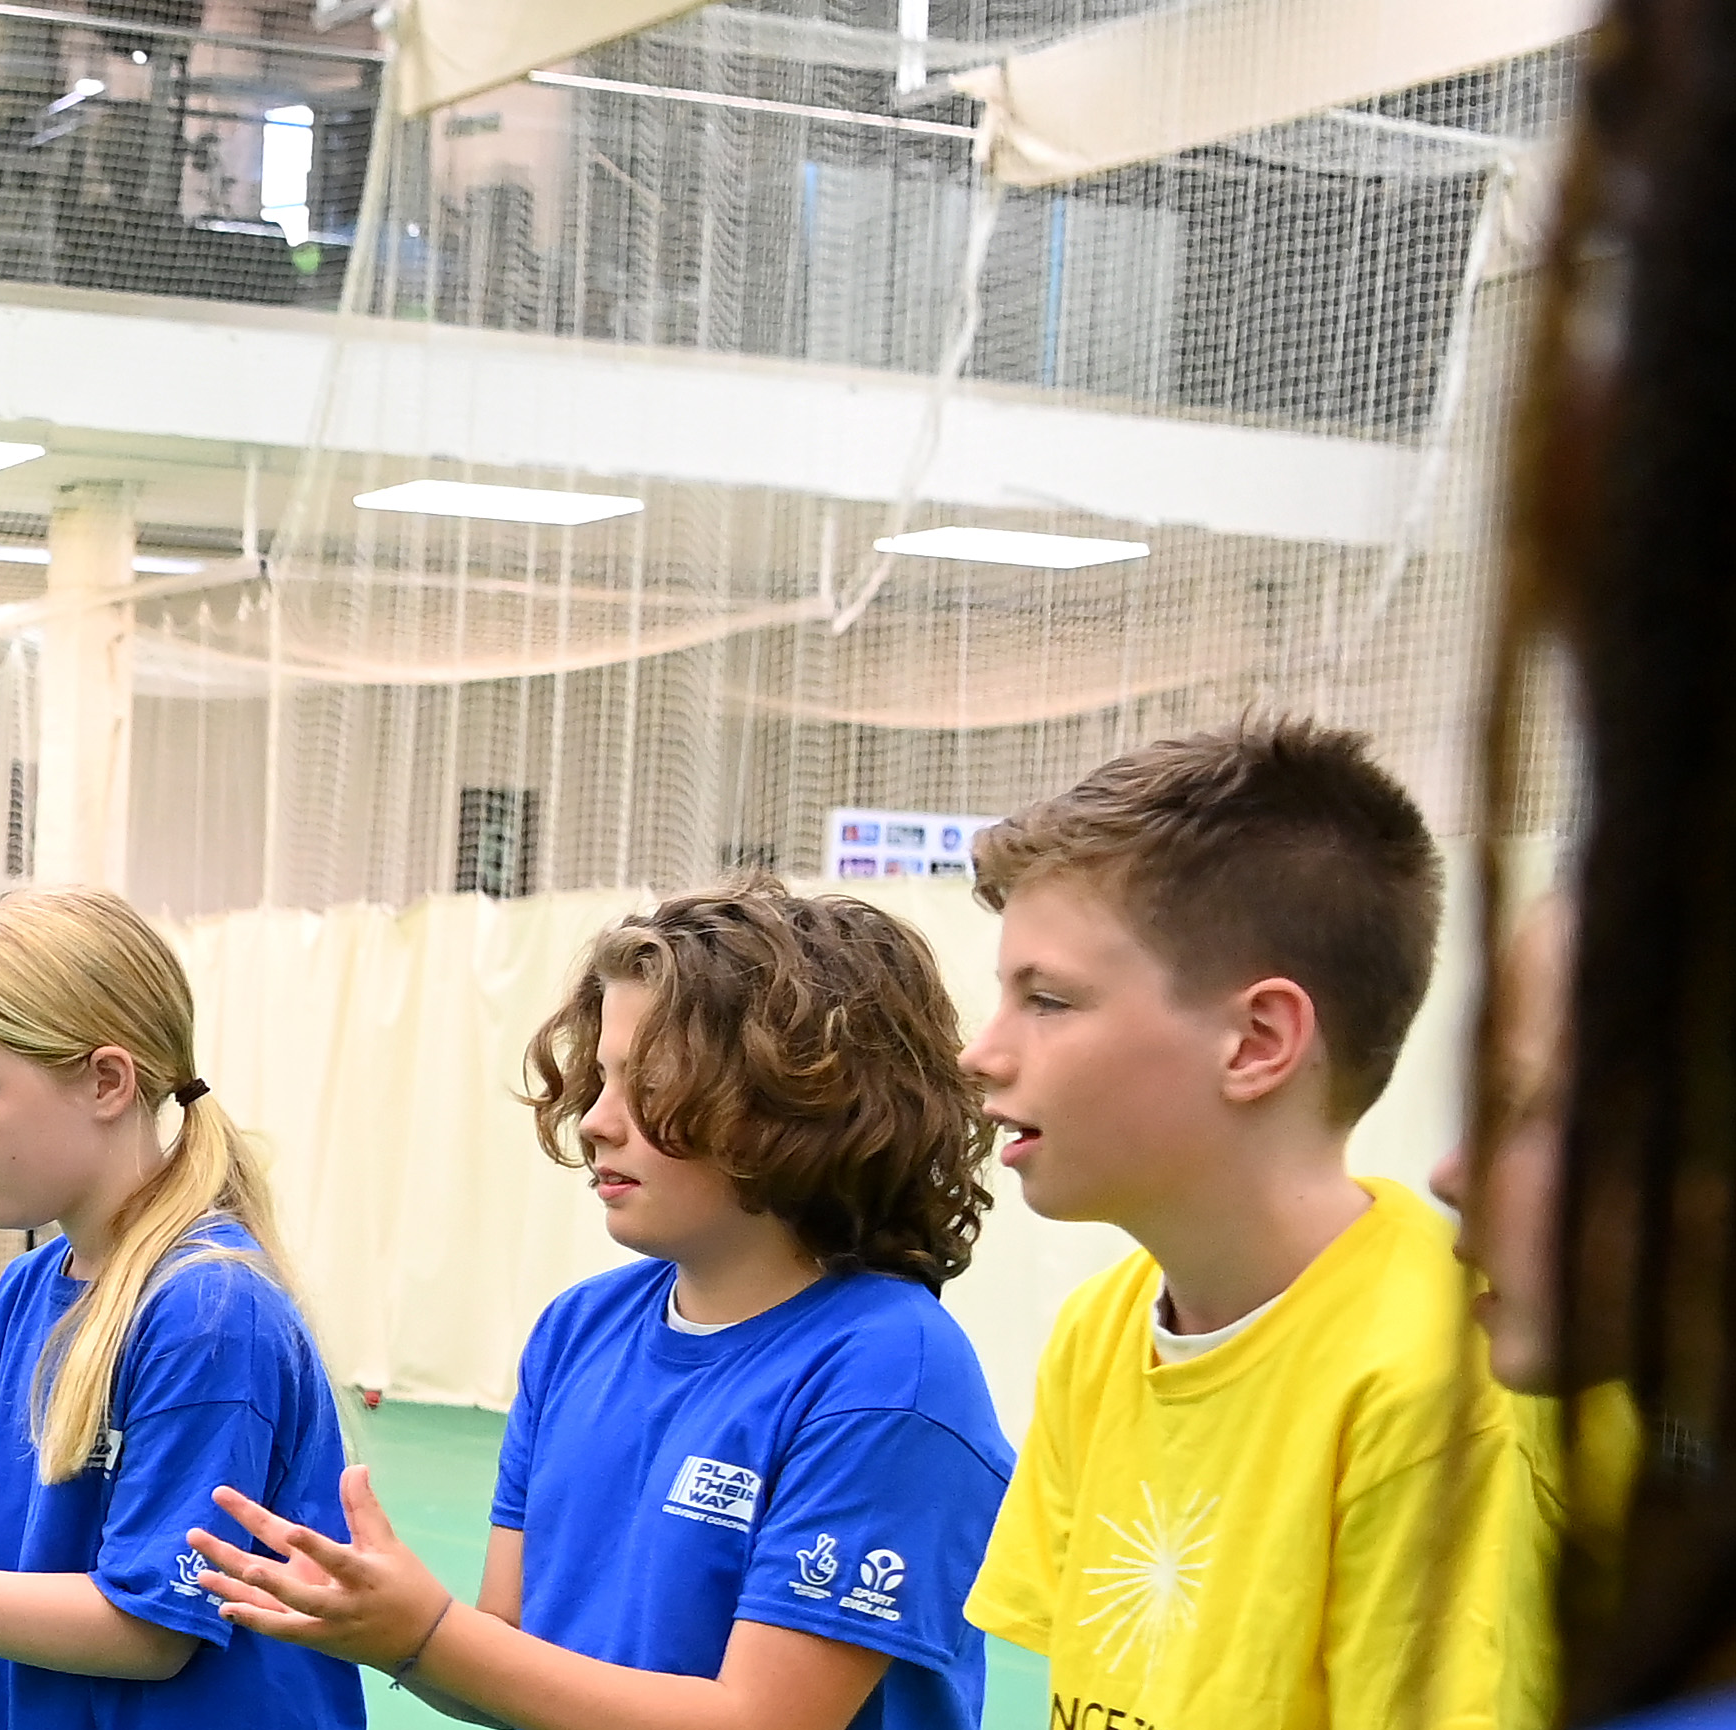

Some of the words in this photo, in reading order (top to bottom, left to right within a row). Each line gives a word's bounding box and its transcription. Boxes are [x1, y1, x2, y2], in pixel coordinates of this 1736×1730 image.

[697, 1462, 756, 1487] PLAY
[689, 1490, 736, 1510] WAY
[851, 1587, 897, 1607] SPORT
[838, 1596, 901, 1622] ENGLAND
